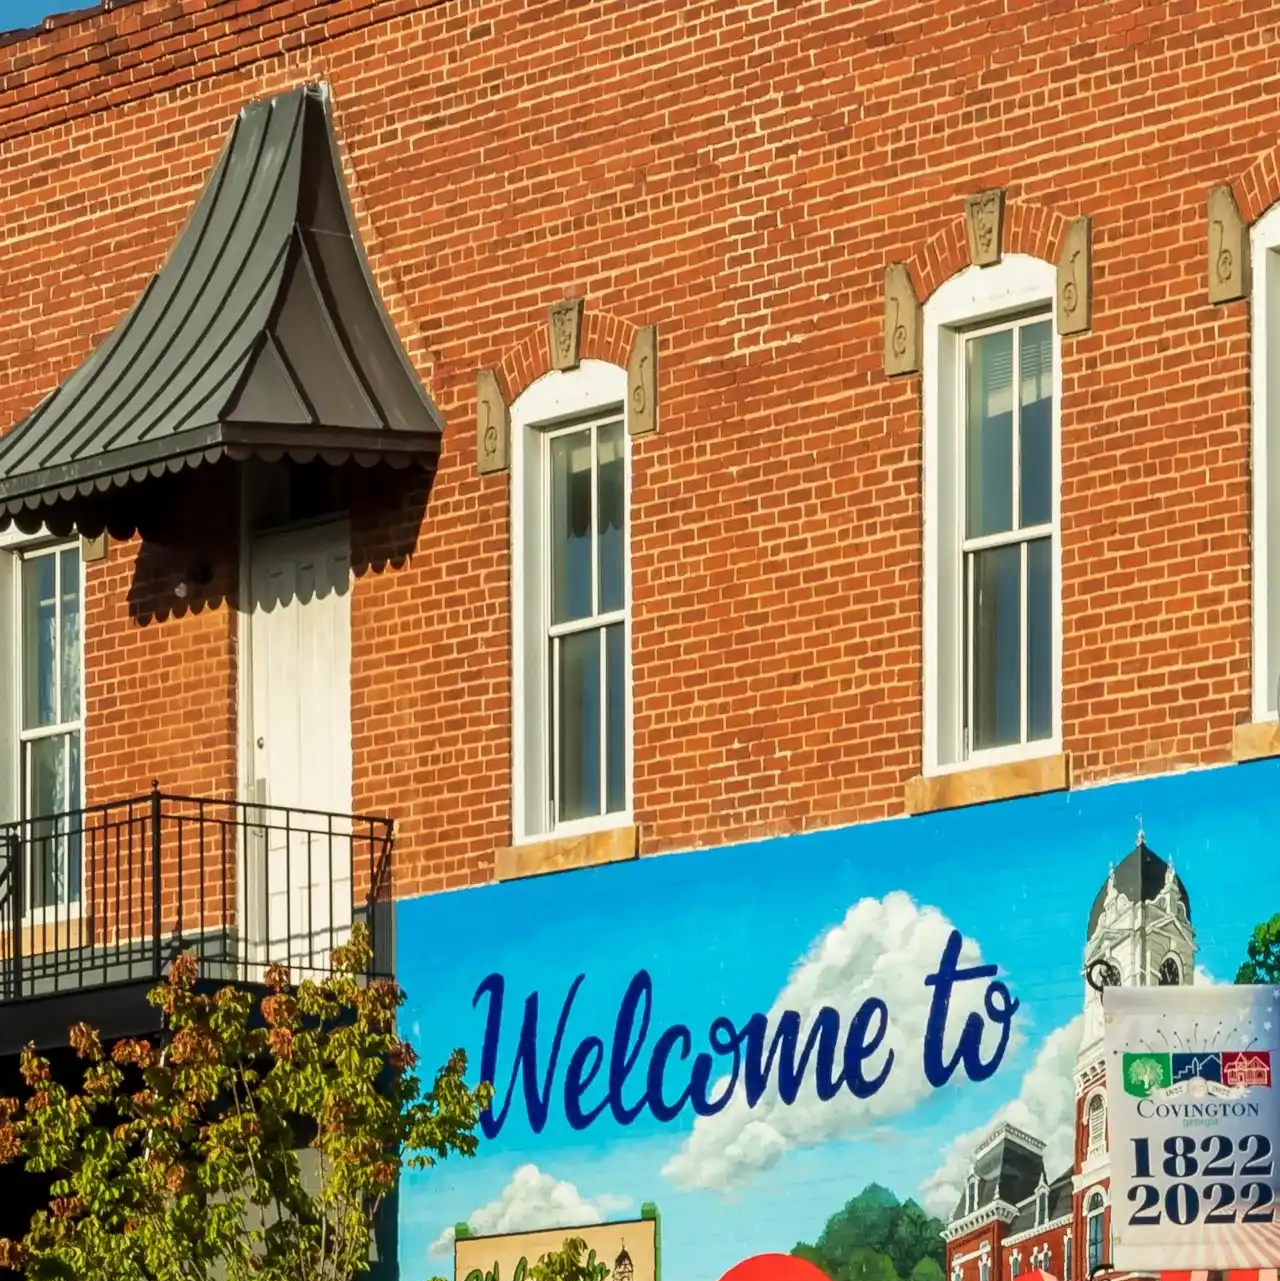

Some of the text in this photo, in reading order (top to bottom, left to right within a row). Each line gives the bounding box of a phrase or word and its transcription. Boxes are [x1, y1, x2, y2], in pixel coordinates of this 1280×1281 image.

[472, 928, 1020, 1140] Welcome to
[1136, 1098, 1260, 1119] COVINGTON
[1128, 1134, 1276, 1179] 1822
[1126, 1182, 1277, 1227] 2022
